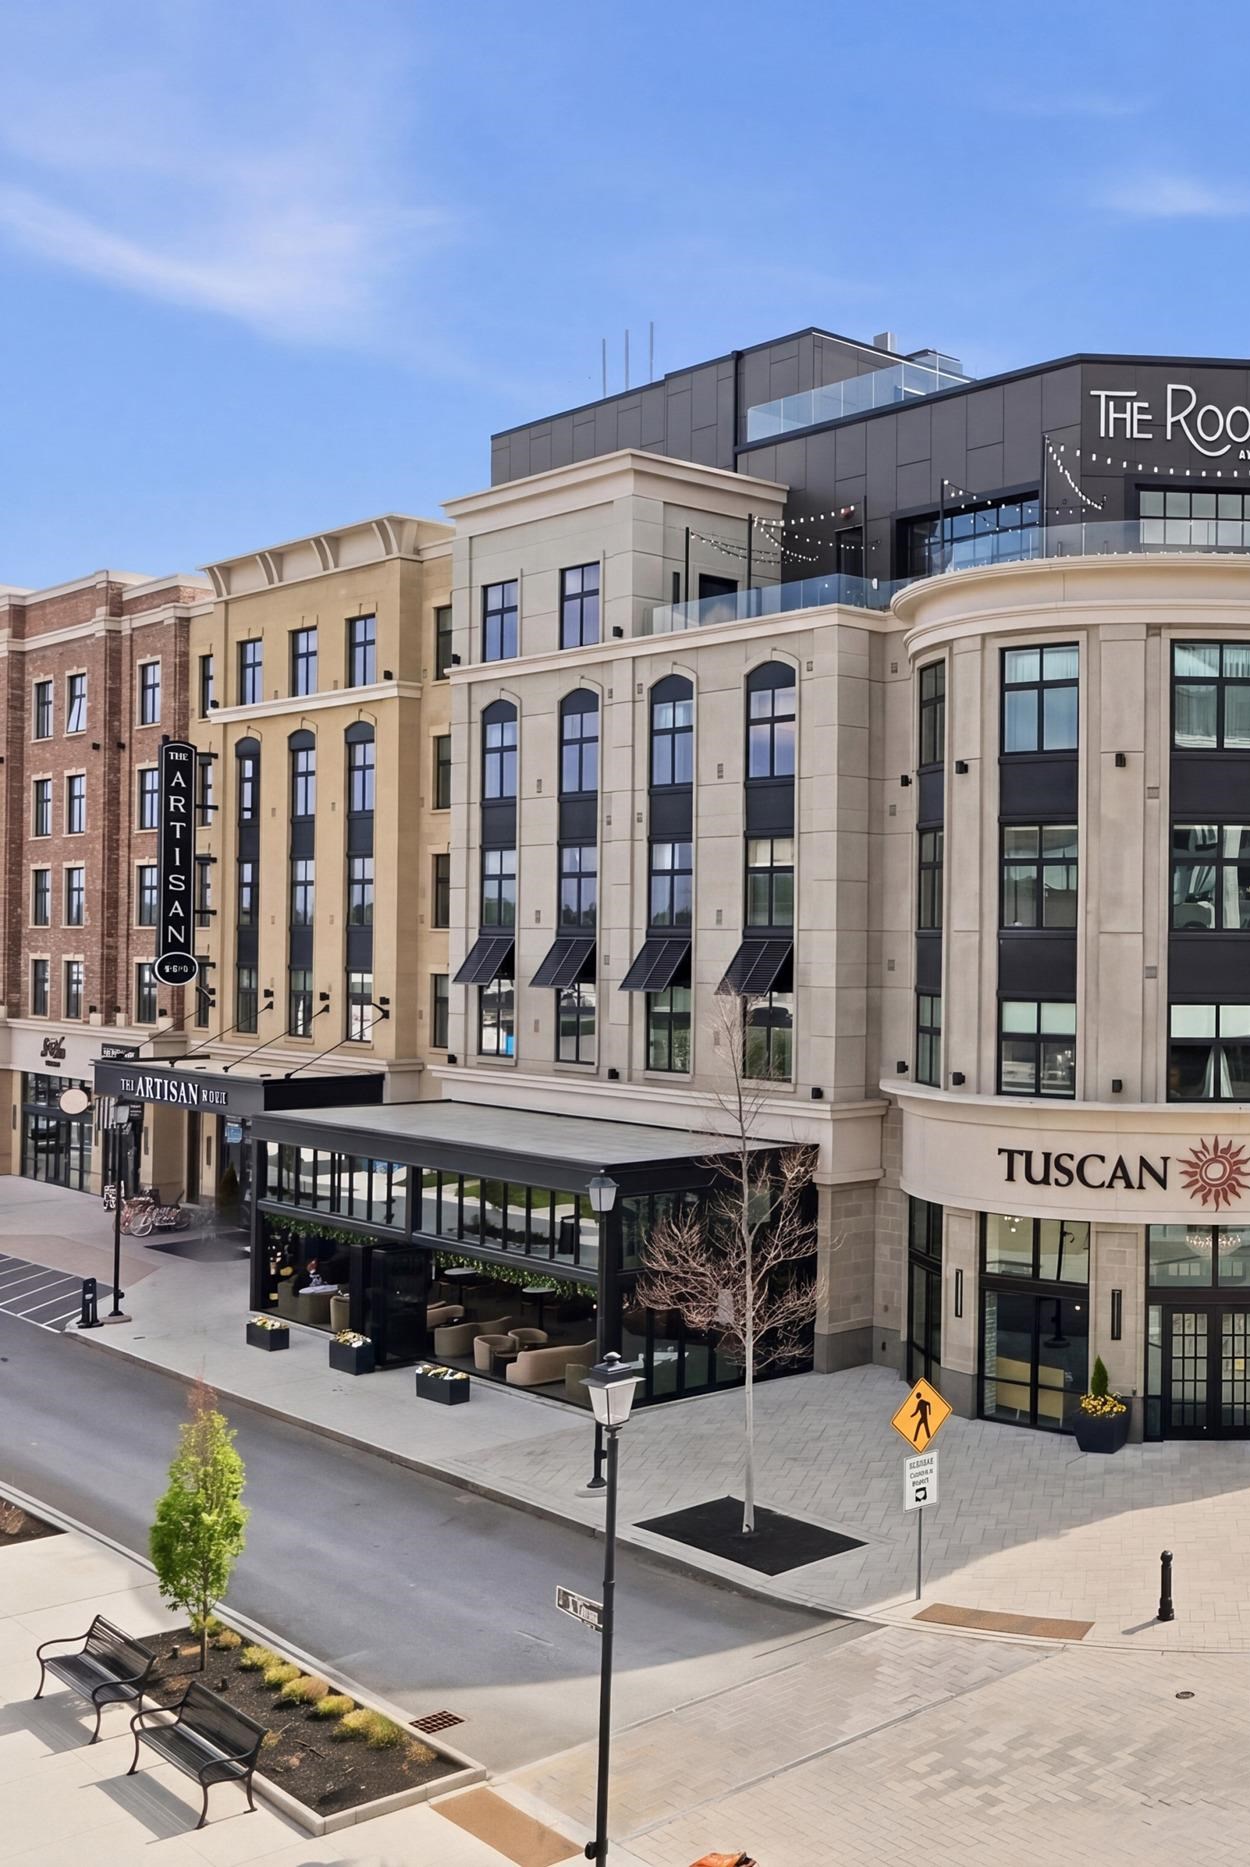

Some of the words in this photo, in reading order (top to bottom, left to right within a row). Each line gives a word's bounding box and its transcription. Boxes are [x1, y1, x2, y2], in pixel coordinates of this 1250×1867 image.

[1090, 390, 1153, 439] THE
[168, 751, 189, 761] THE
[168, 771, 186, 944] ARTISAN
[135, 1076, 198, 1105] ARTISAN
[998, 1148, 1171, 1191] TUSCAN
